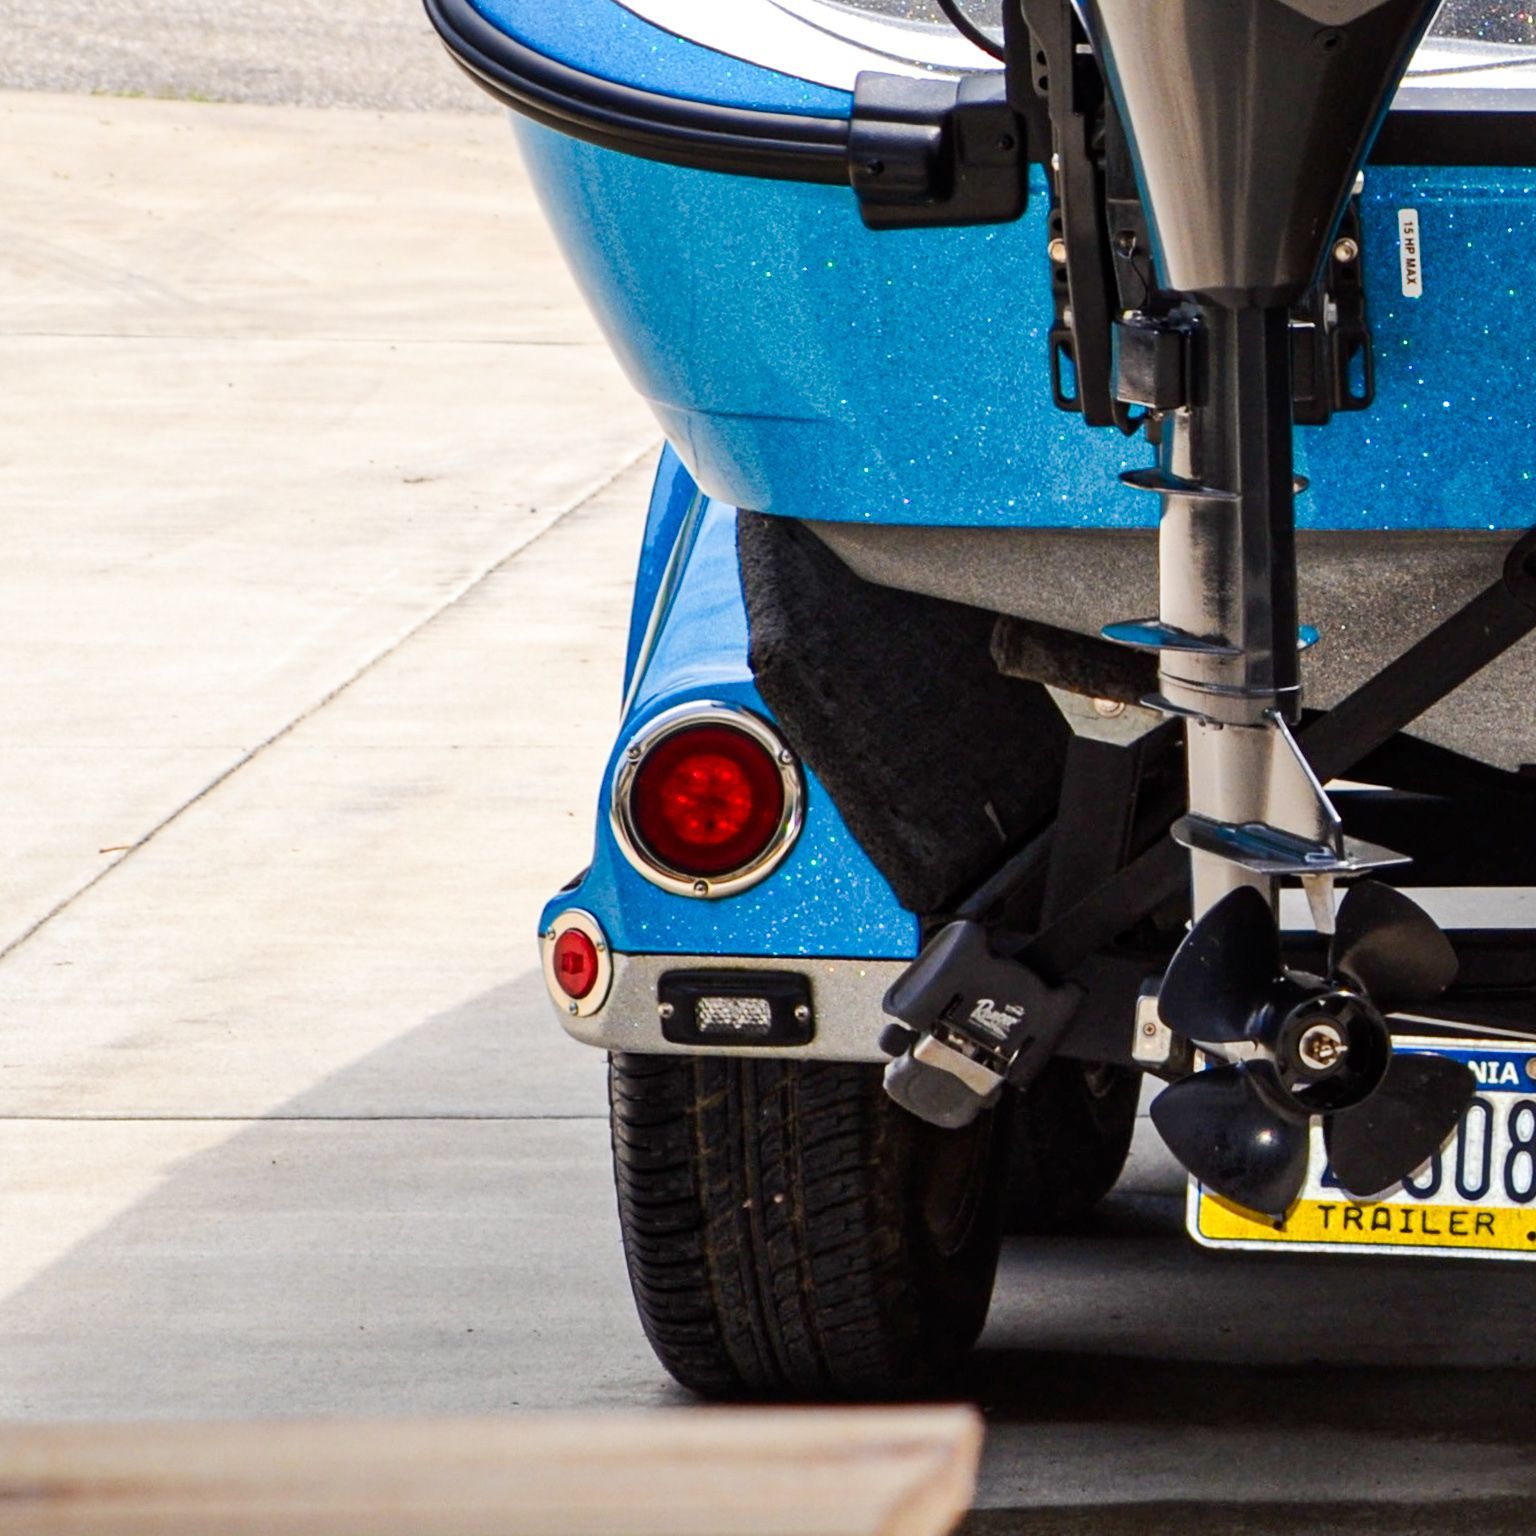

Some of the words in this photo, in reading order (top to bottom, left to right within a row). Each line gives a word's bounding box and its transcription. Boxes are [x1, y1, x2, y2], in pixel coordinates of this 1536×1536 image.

[1403, 221, 1414, 234] 15
[1404, 237, 1416, 255] HP
[1406, 259, 1417, 285] MAX
[1468, 1060, 1520, 1085] NIA
[1318, 1204, 1495, 1236] TRAILER
